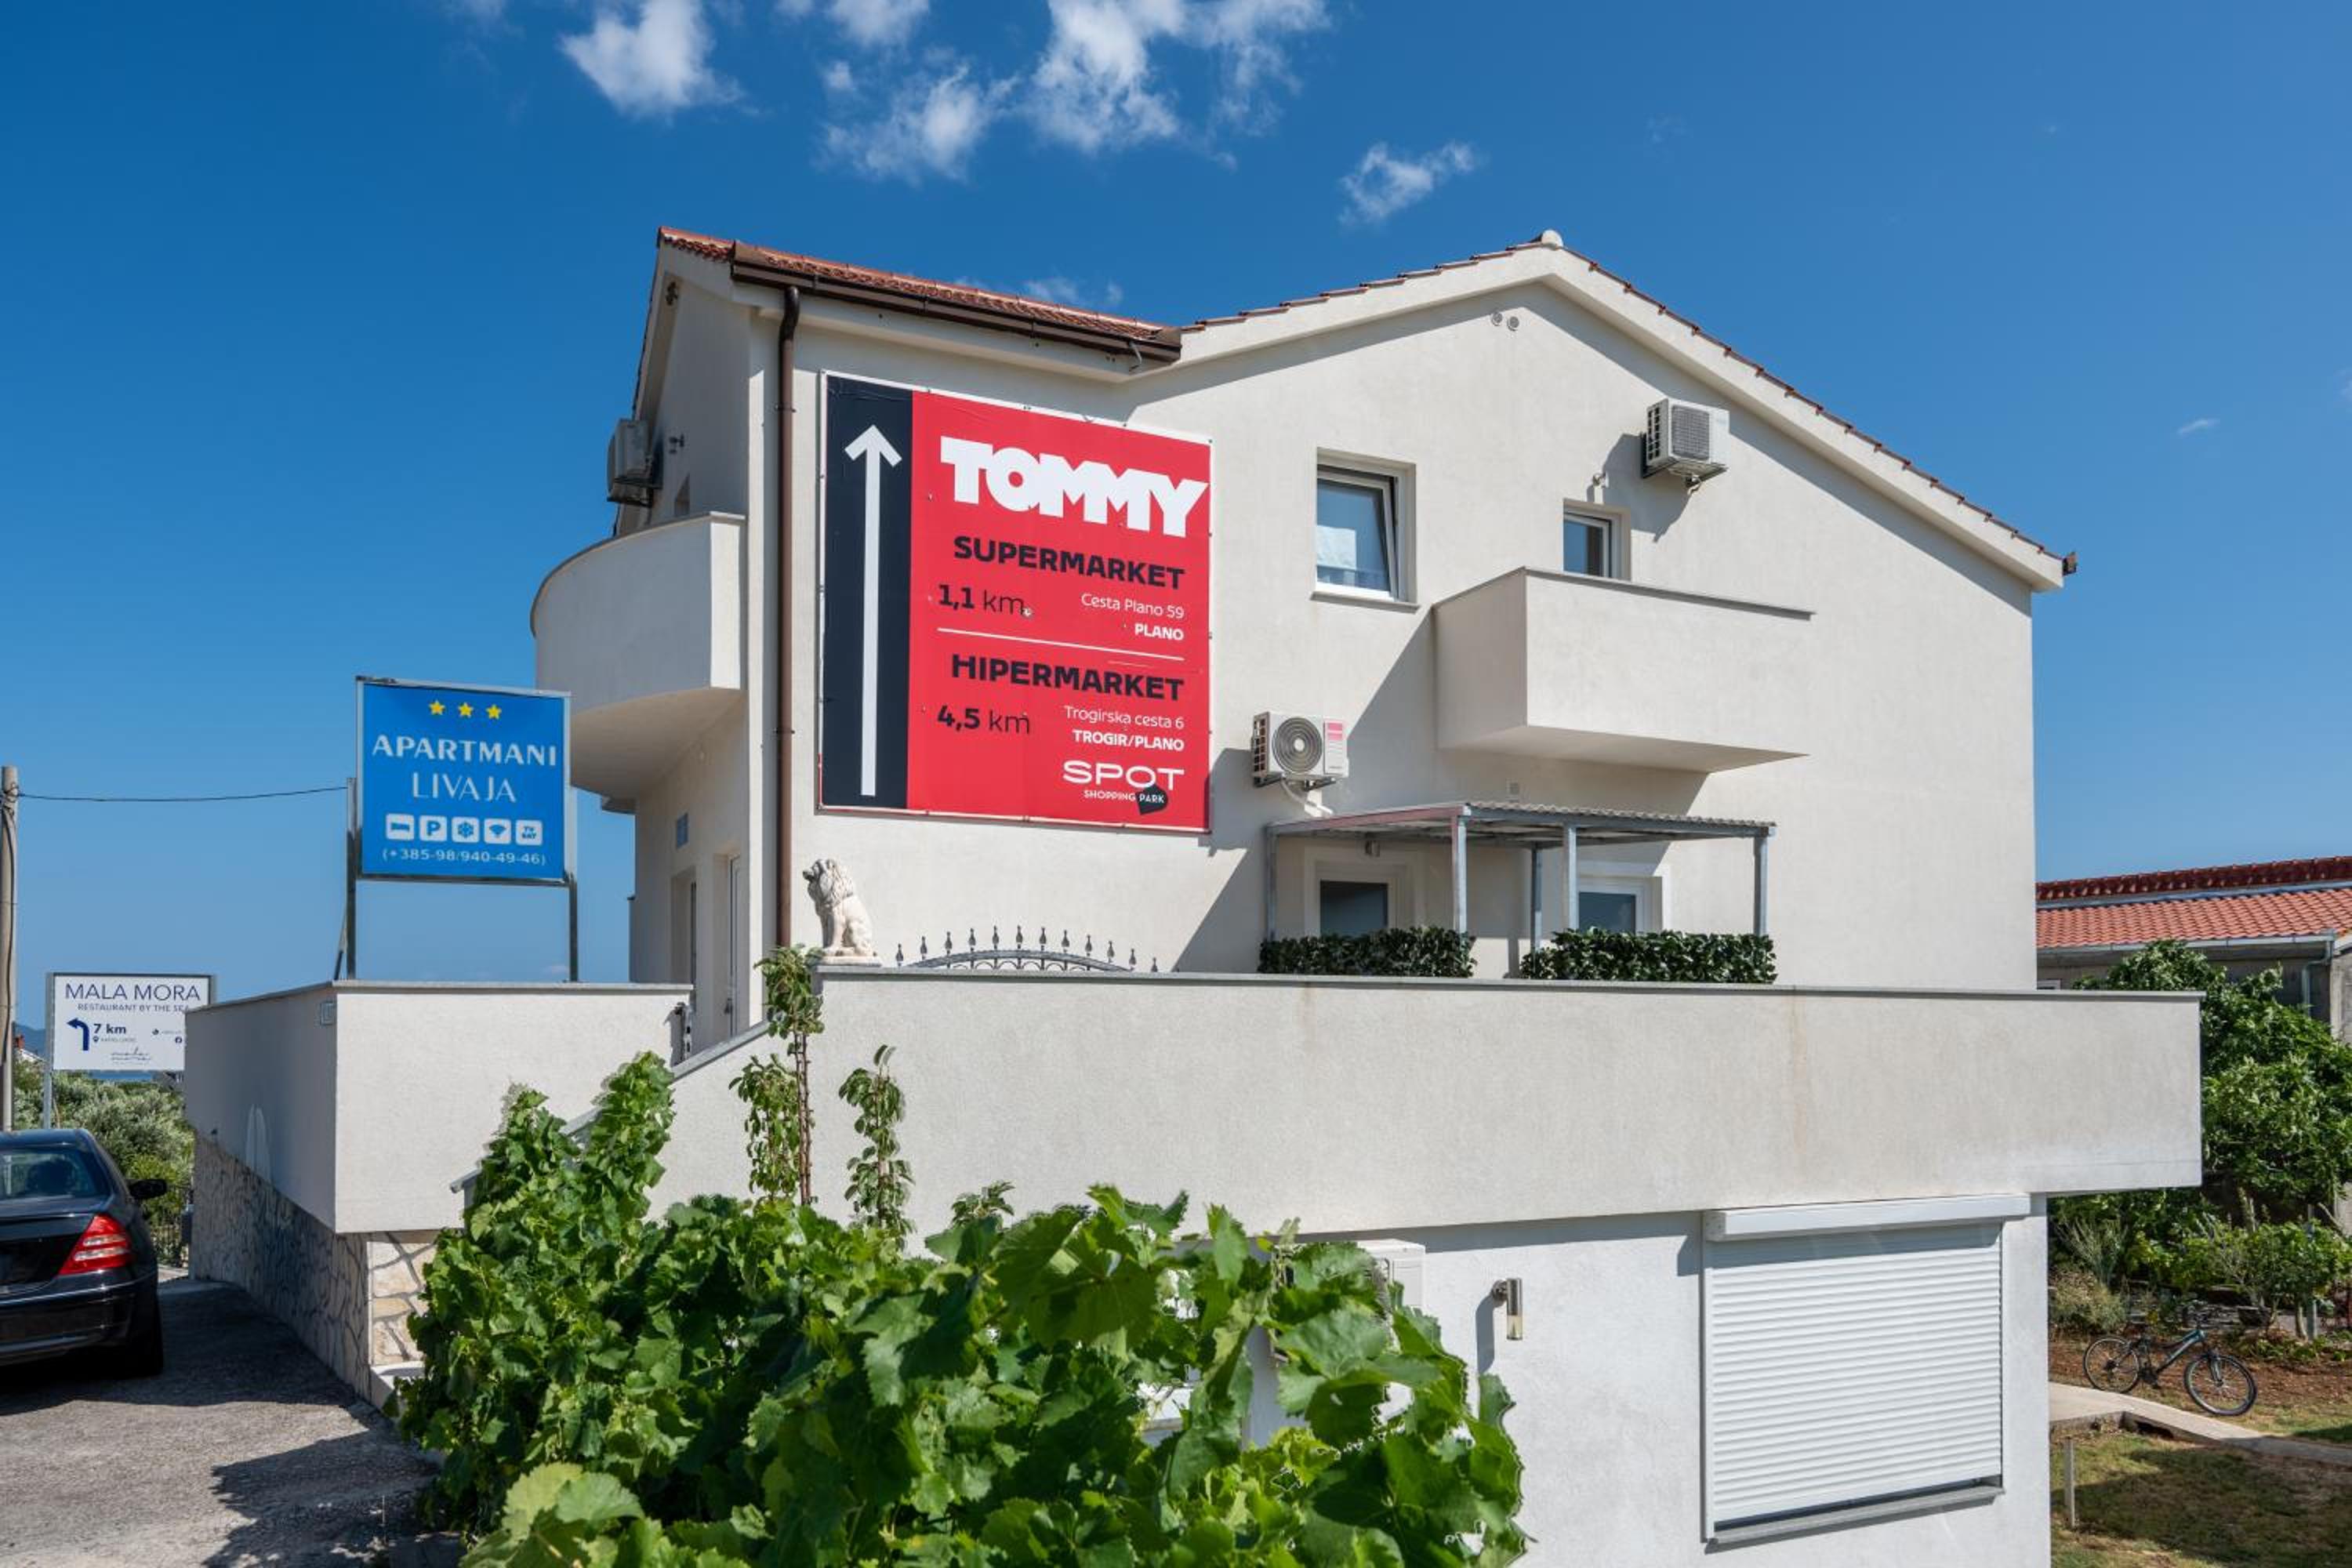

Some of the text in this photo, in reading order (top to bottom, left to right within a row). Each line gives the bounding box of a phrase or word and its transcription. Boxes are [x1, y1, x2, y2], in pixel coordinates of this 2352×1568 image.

[941, 436, 1209, 538] TOMMY
[953, 535, 1185, 590] SUPERMARKET
[938, 584, 1025, 615] 1,1 km
[1081, 593, 1185, 619] Cesta Plano 59
[1134, 623, 1184, 641] PLANO
[952, 654, 1185, 701] HIPERMARKET
[937, 705, 1030, 734] 4,5 km
[1064, 705, 1185, 729] Trogirska cesta 6
[372, 735, 556, 766] APARTMANI
[1073, 729, 1185, 751] TROGIR/PLANO
[413, 771, 517, 803] LIVAJA
[1063, 760, 1185, 790] SPOT
[1083, 789, 1165, 804] SHOPPING PARK
[65, 983, 201, 1000] MALA MORA
[93, 1023, 127, 1034] 7 km
